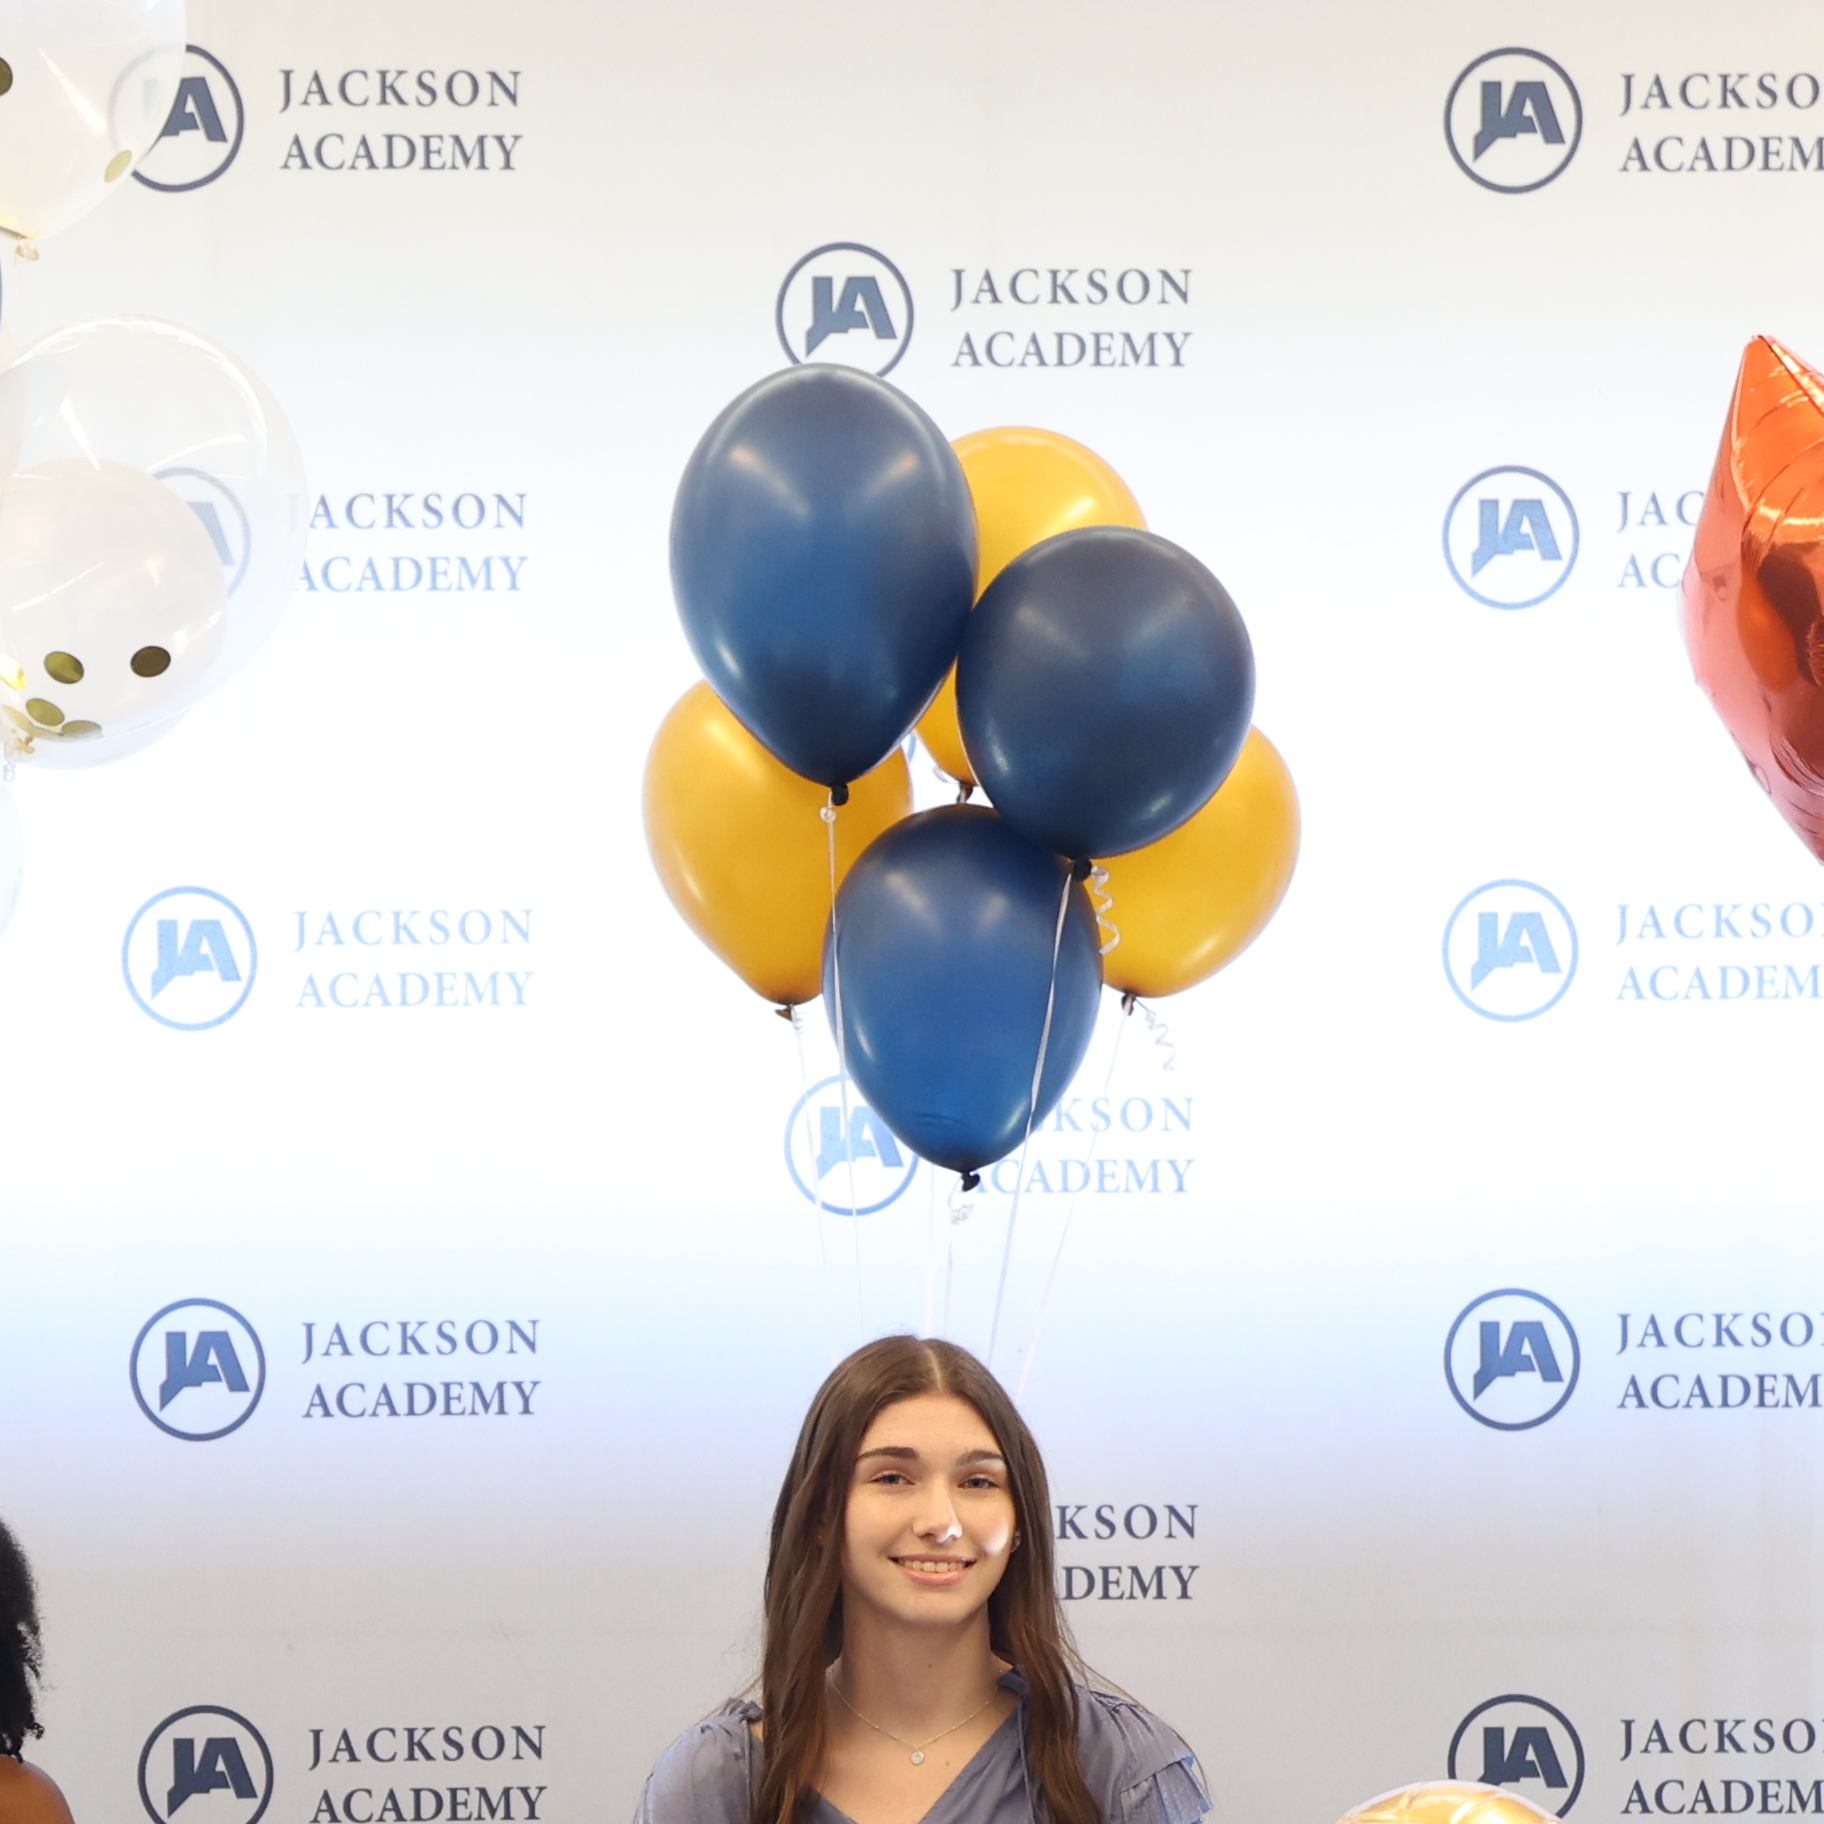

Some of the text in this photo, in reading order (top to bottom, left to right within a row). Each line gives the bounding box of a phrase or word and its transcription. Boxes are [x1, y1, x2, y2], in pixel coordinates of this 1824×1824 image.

[280, 69, 521, 113] JACKSON
[280, 133, 523, 171] ACADEMY
[951, 268, 1192, 311] JACKSON
[951, 331, 1192, 368] ACADEMY
[286, 492, 527, 536] JACKSON
[294, 909, 533, 953] JACKSON
[296, 971, 534, 1008] ACADEMY
[1056, 1096, 1195, 1133] KSON
[301, 1319, 539, 1365] JACKSON
[302, 1380, 541, 1418] ACADEMY
[1055, 1504, 1199, 1541] KSON
[1061, 1565, 1200, 1601] DEMY
[308, 1725, 546, 1772] JACKSON
[309, 1785, 548, 1824] ACADEMY
